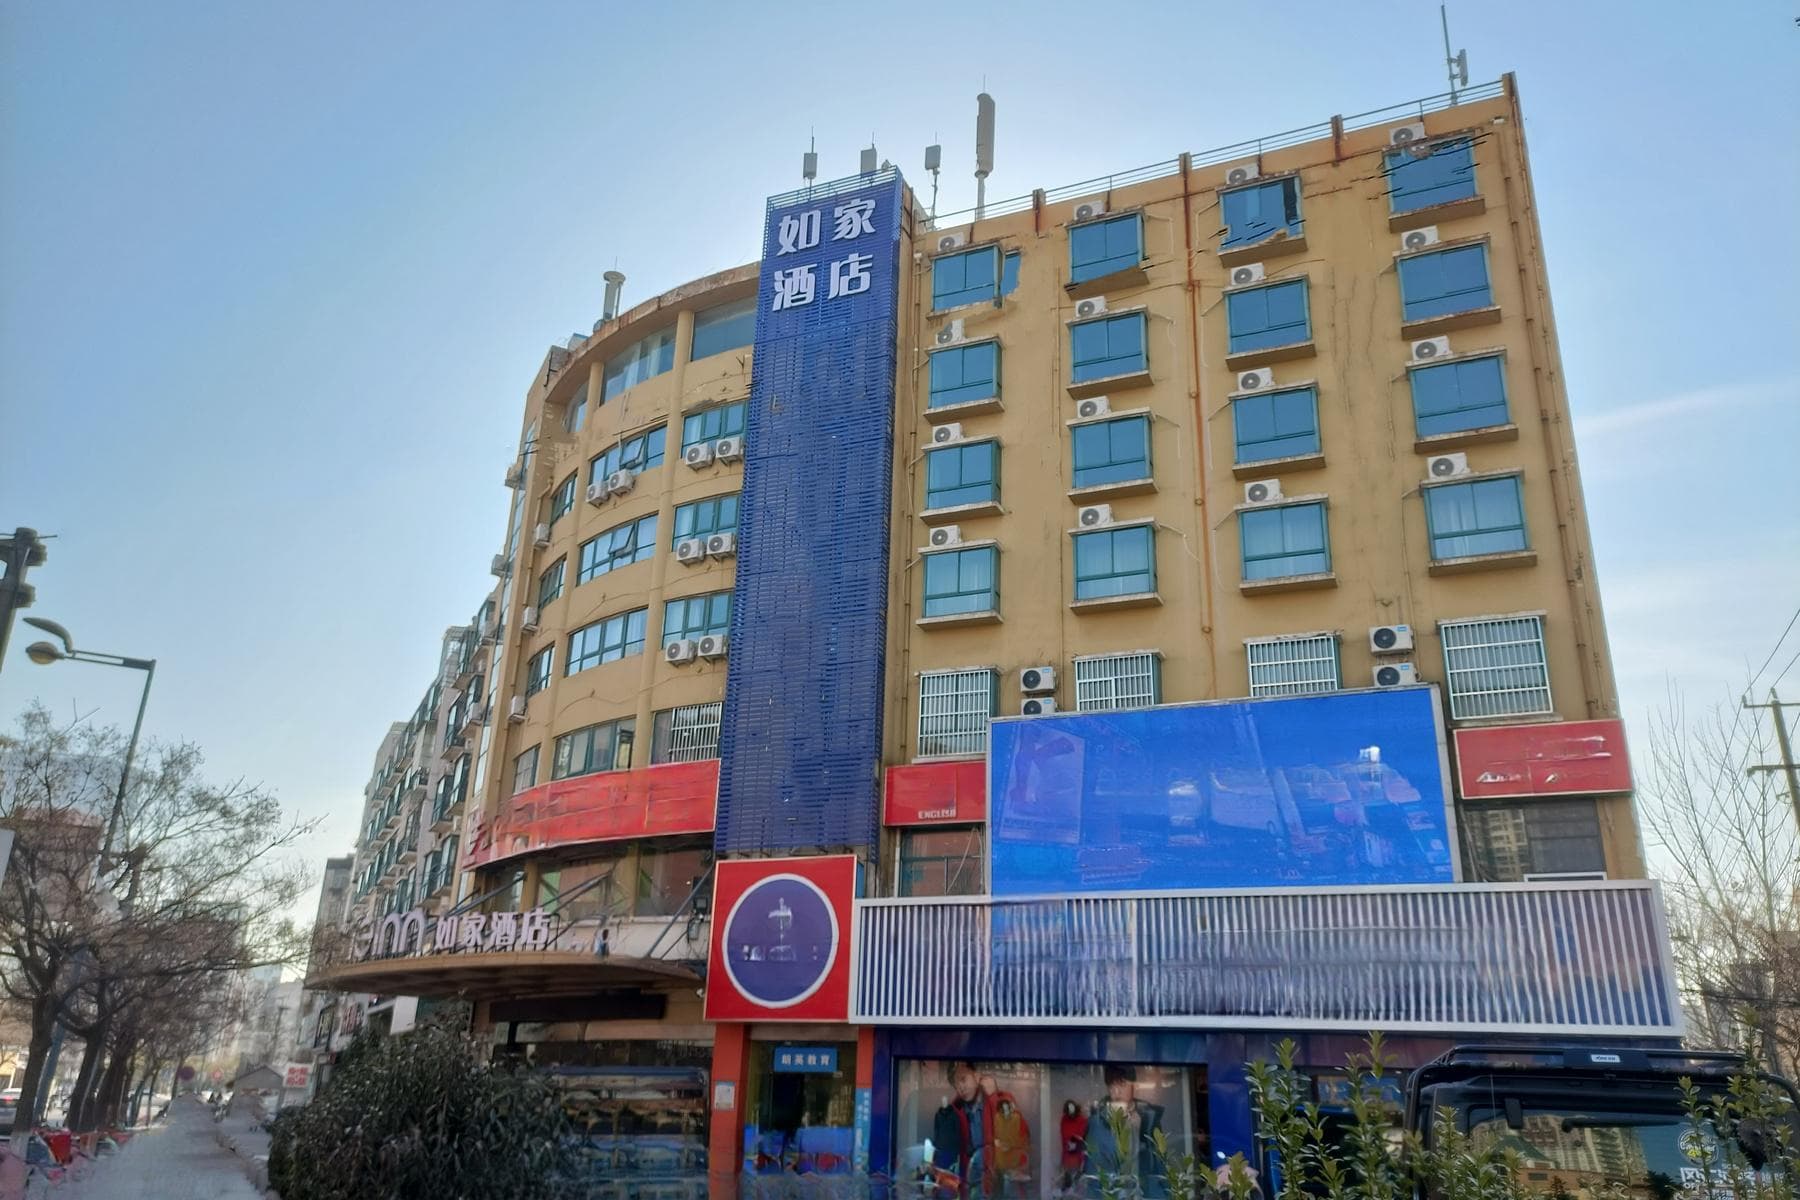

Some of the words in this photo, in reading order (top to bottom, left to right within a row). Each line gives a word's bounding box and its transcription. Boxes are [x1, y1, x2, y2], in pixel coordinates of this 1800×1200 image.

[776, 198, 876, 257] 如家
[772, 253, 873, 312] 酒店
[919, 809, 956, 819] ENGLISH
[433, 907, 551, 951] 如家酒店
